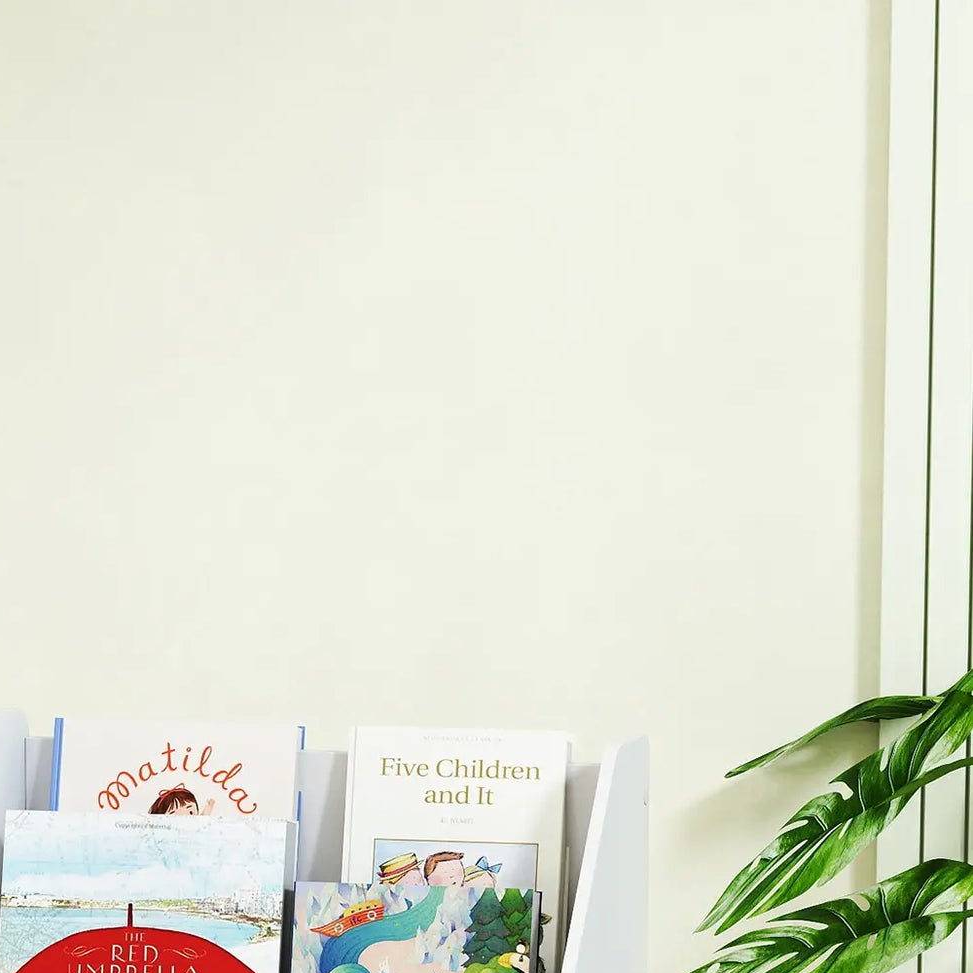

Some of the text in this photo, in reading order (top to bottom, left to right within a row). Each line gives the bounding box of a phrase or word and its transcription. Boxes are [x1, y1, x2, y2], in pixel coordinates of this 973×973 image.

[98, 742, 257, 814] Matilda
[380, 757, 541, 781] Five Children
[424, 785, 494, 805] and It
[124, 932, 146, 942] THE
[111, 944, 159, 964] RED
